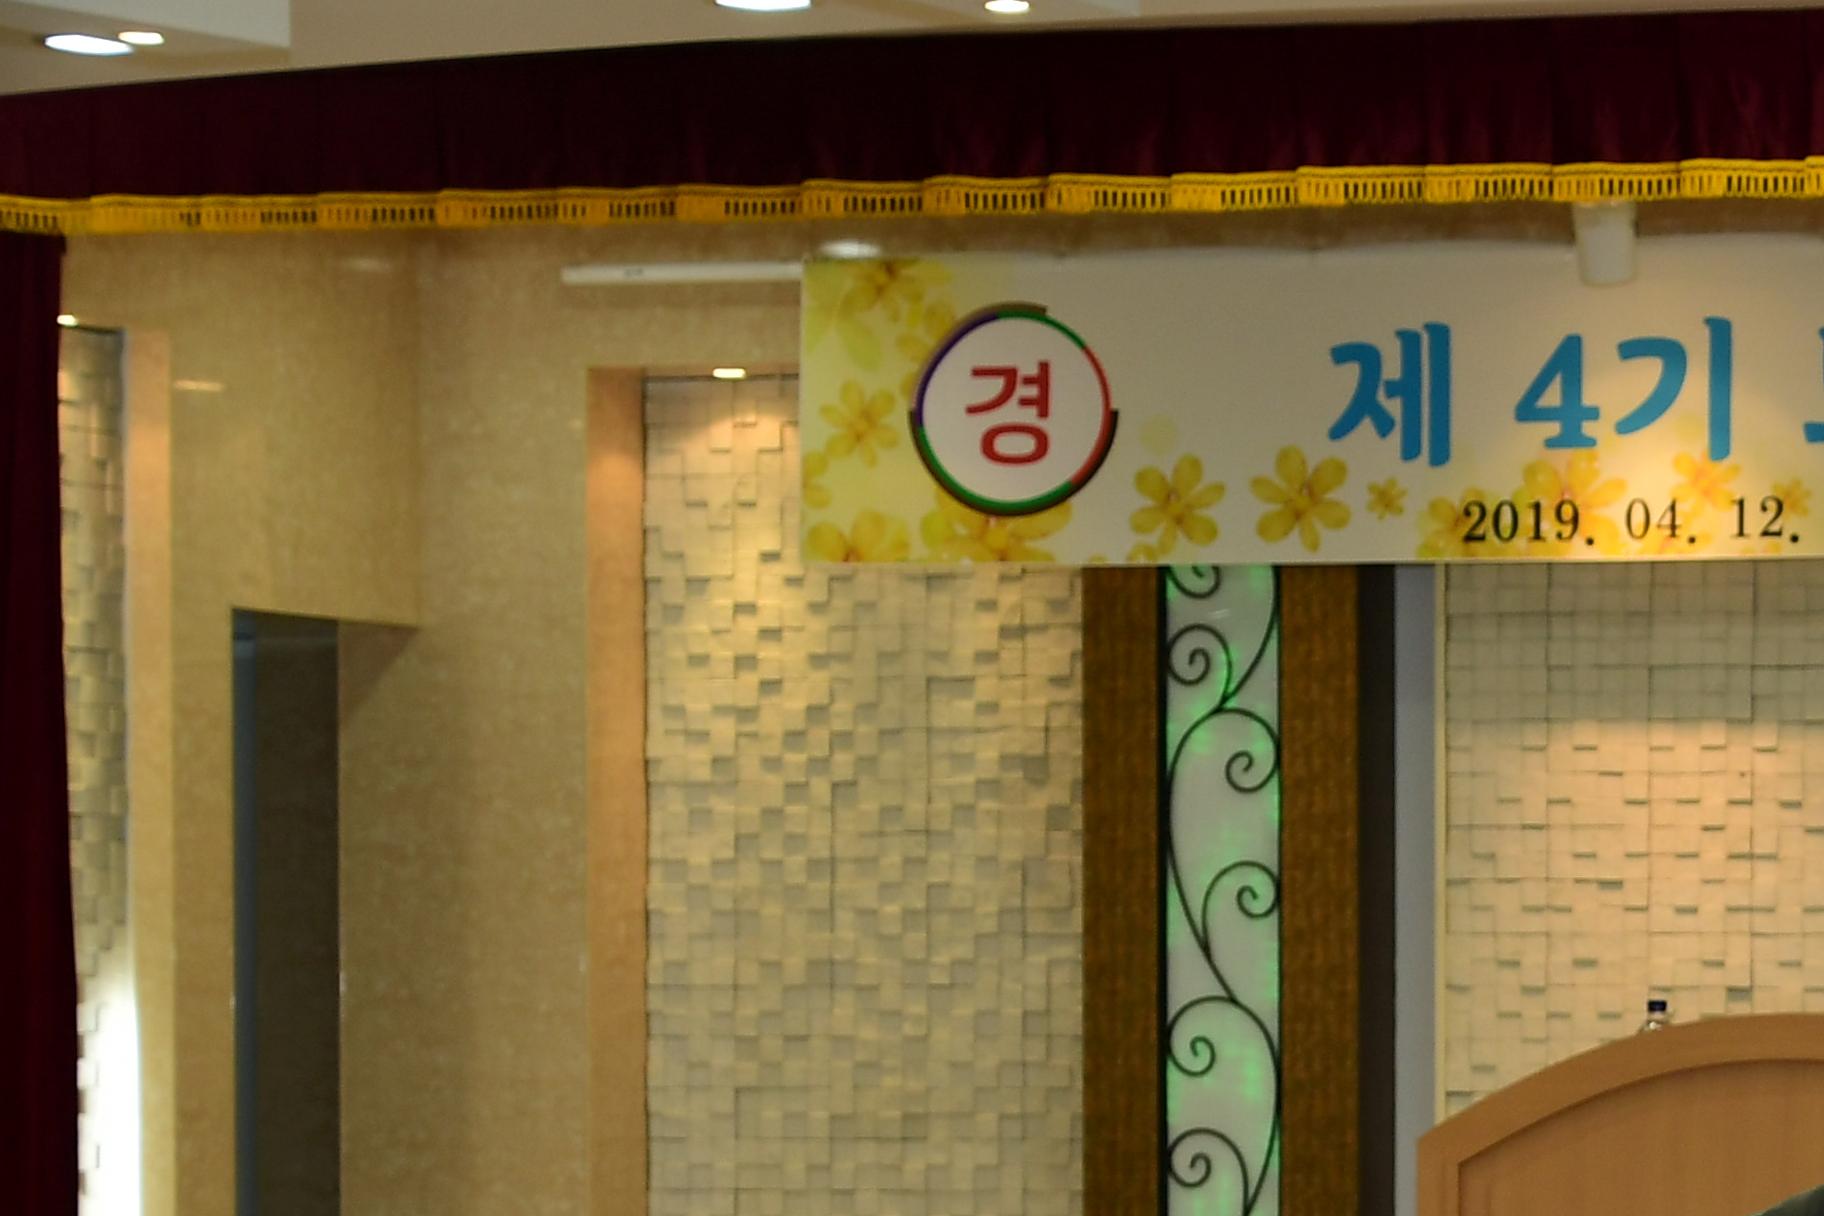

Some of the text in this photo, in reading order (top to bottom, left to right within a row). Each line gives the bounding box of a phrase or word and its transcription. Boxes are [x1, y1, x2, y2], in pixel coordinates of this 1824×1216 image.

[966, 361, 1051, 466] 경
[1328, 321, 1452, 468] 제
[1514, 315, 1733, 460] 4기
[1461, 499, 1595, 546] 2019.
[1624, 497, 1698, 544] 04.
[1731, 495, 1800, 543] 12.
